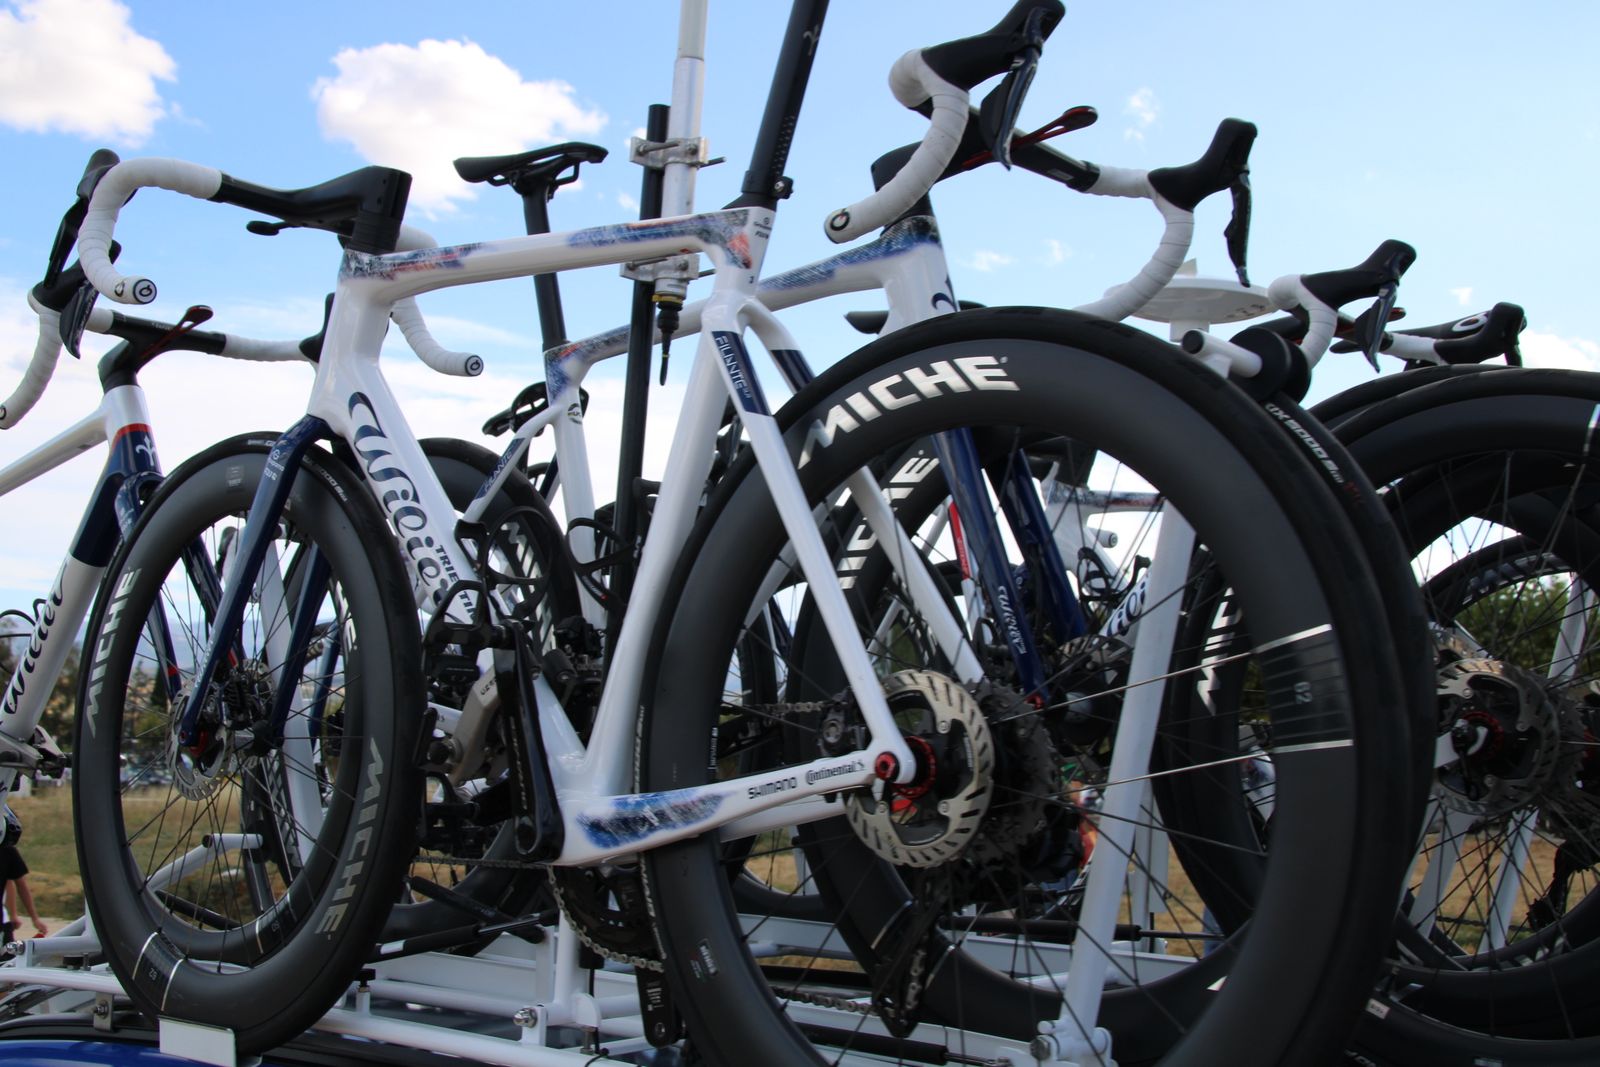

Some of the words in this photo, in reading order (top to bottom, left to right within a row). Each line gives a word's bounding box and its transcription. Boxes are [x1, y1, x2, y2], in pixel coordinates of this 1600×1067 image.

[797, 355, 1021, 470] MICHE
[85, 566, 142, 739] MICHE
[315, 737, 385, 934] MICHE
[747, 775, 798, 799] SHIMANO
[805, 763, 857, 786] Continental
